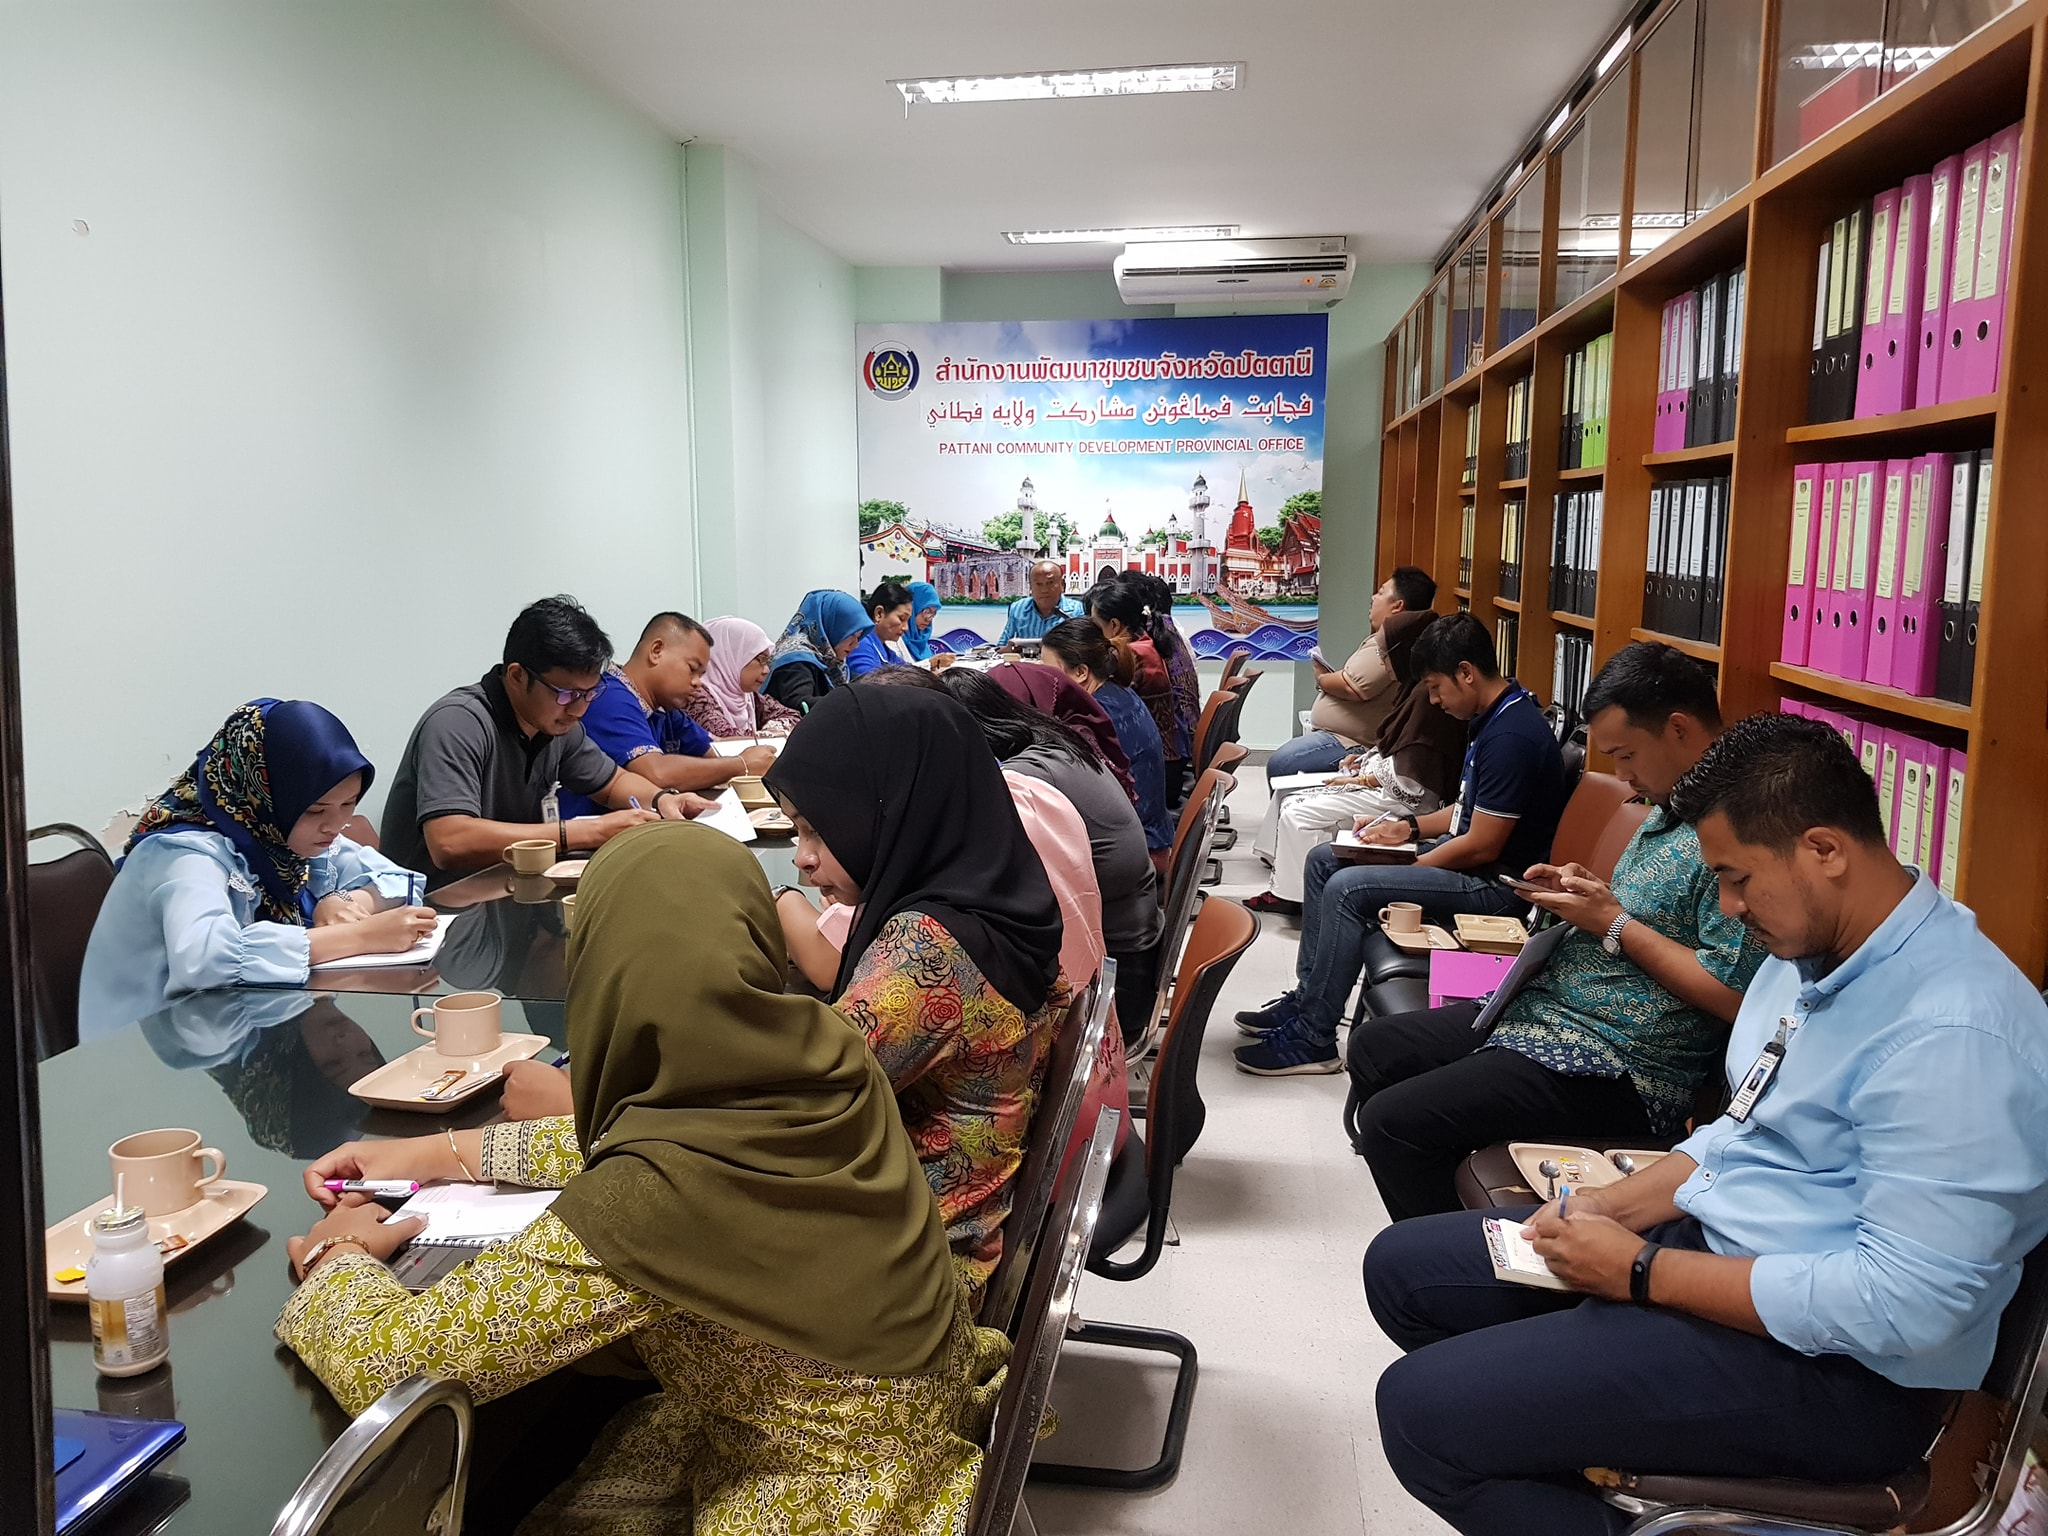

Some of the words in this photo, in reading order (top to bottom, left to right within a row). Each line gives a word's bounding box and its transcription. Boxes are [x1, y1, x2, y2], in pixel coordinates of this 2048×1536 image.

[935, 348, 1313, 385] สำนักงานพัฒนาชุมชนจังหวัดปัตตานี
[939, 442, 992, 455] PATTANI
[996, 441, 1074, 454] COMMUNITY
[1078, 440, 1172, 453] DEVELOPMENT
[1176, 439, 1254, 452] PROVINCIAL
[1258, 438, 1304, 450] OFFICE
